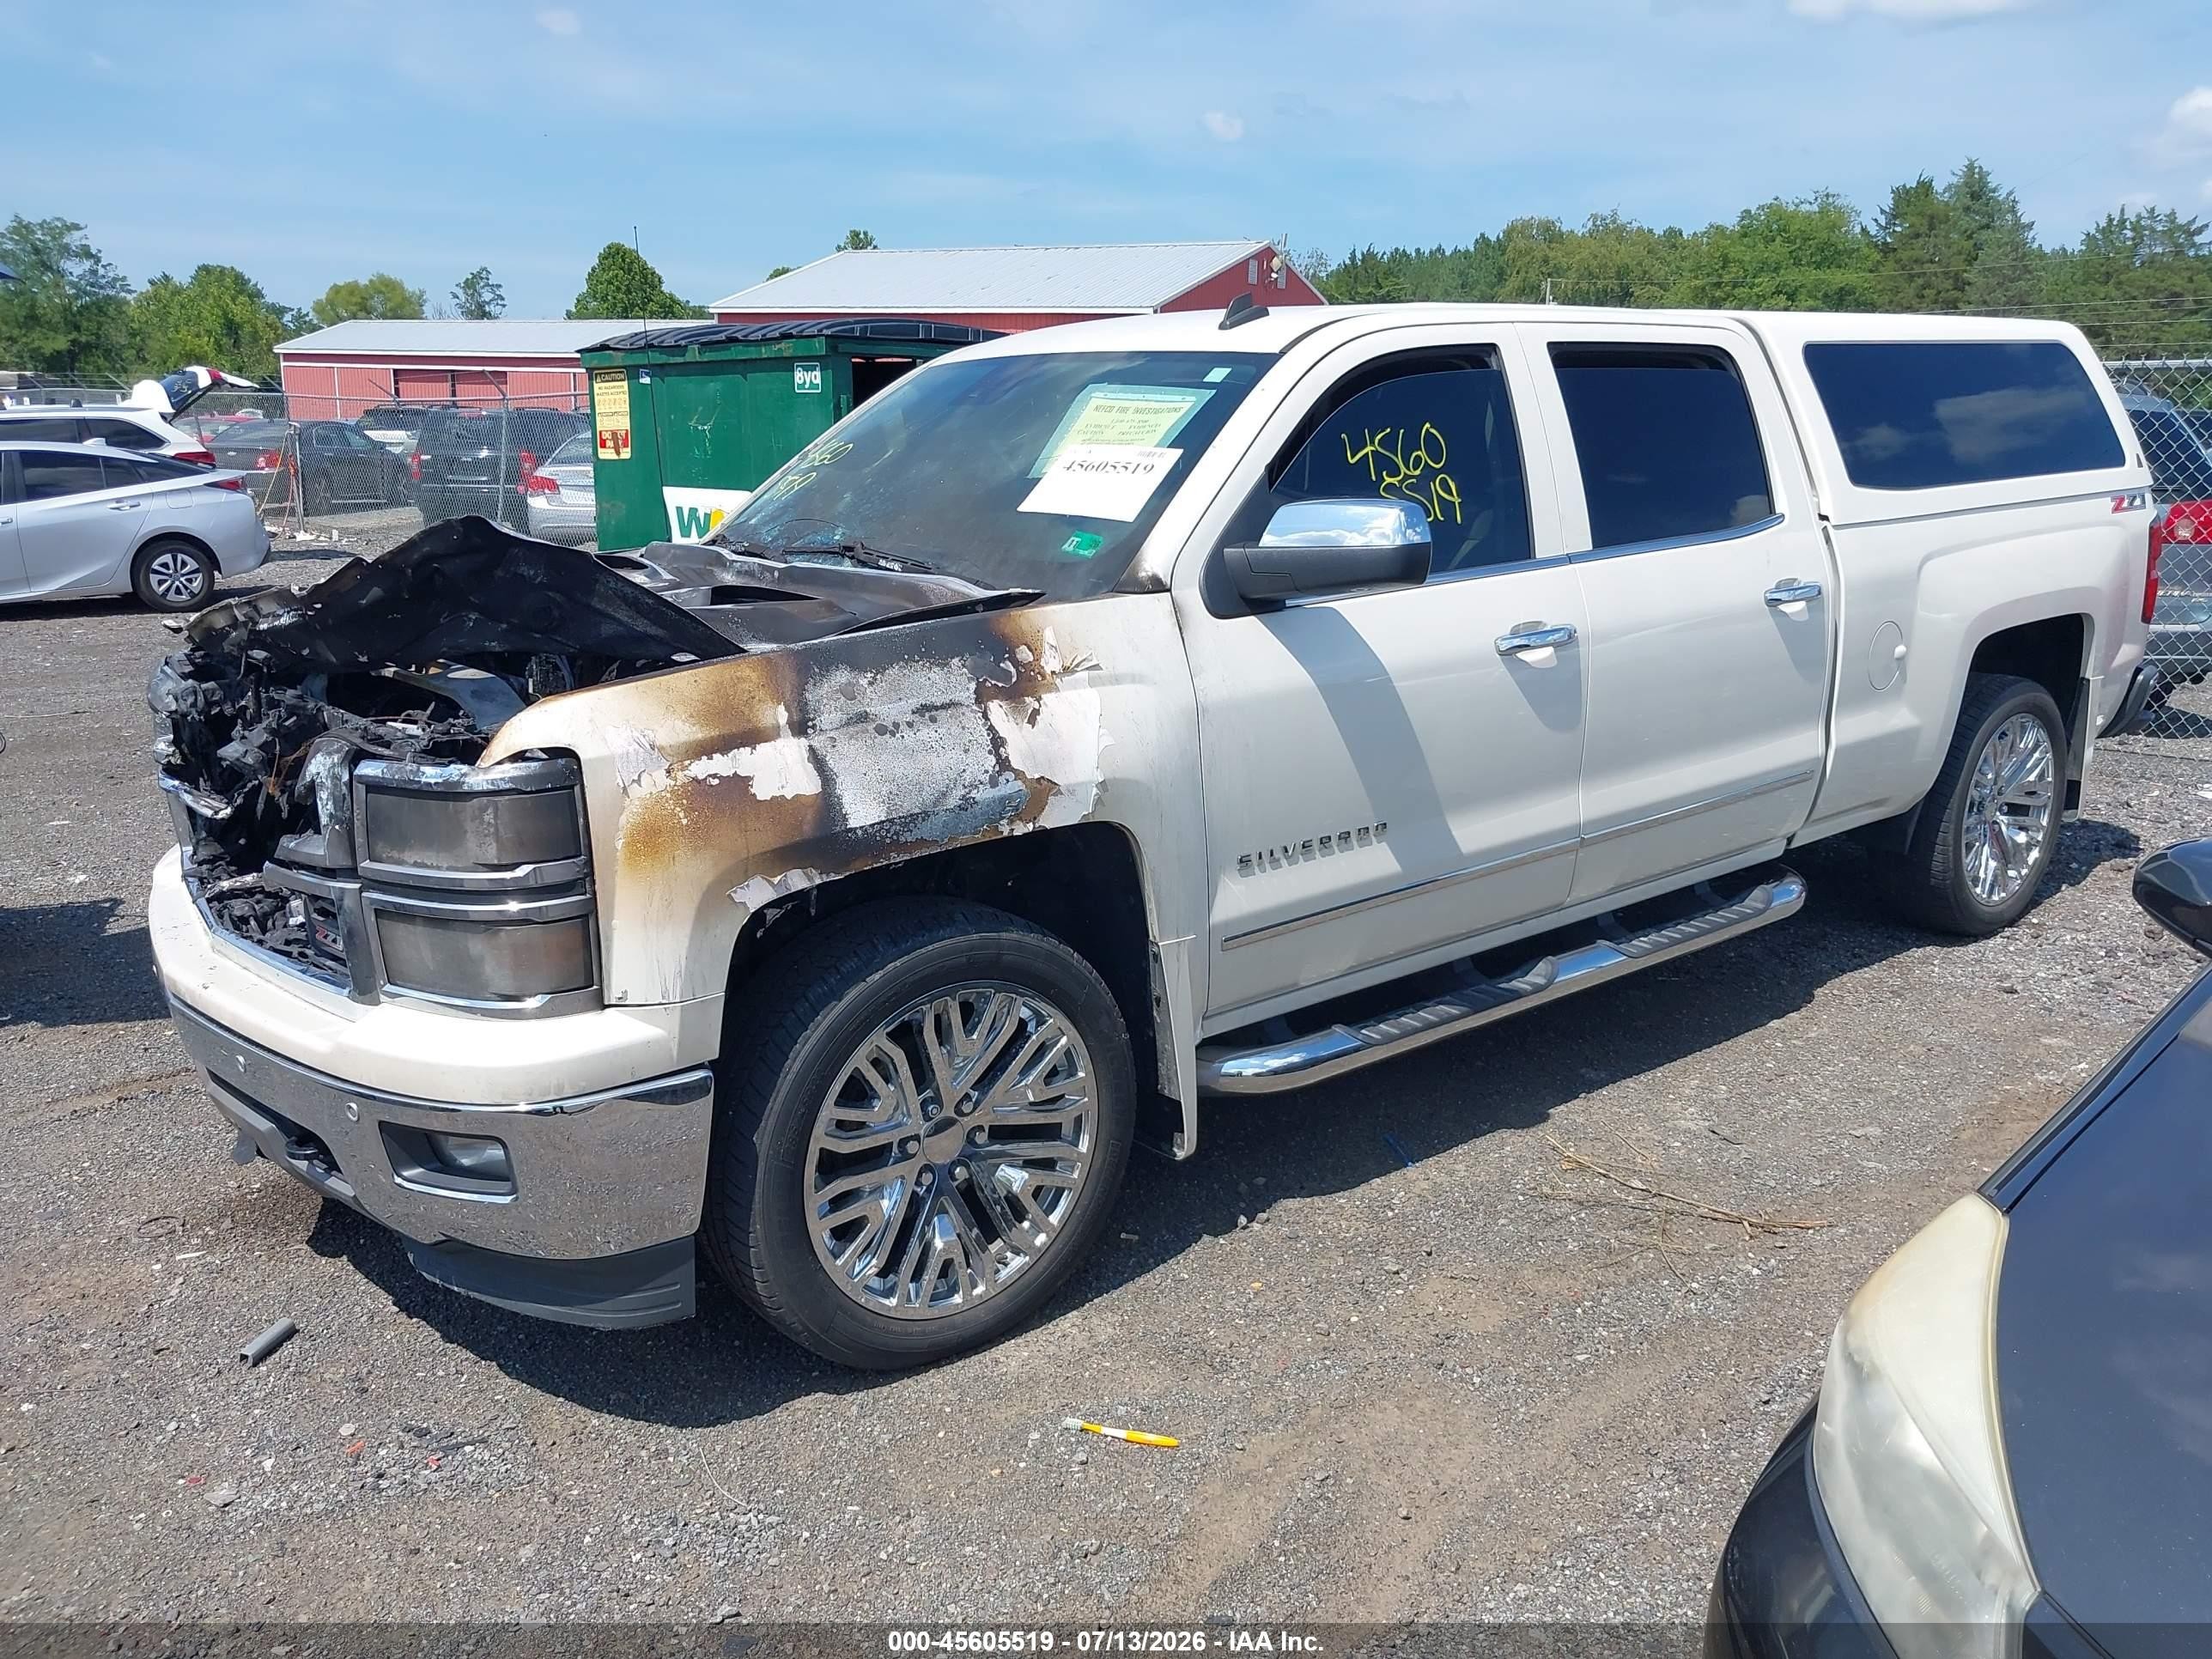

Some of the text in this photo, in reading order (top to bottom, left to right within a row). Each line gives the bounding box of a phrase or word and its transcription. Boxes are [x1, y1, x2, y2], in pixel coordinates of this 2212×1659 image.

[601, 373, 625, 382] CAUTION
[796, 366, 820, 389] 8yd
[1115, 405, 1133, 415] FIRE
[1132, 406, 1183, 416] INVESTIGATIONS
[602, 431, 612, 440] DO
[605, 439, 624, 448] PAK
[1340, 421, 1447, 483] 4560
[1062, 459, 1156, 475] 45605519
[2110, 492, 2147, 514] Z71
[675, 506, 728, 539] W
[1237, 821, 1388, 868] SILVERADO
